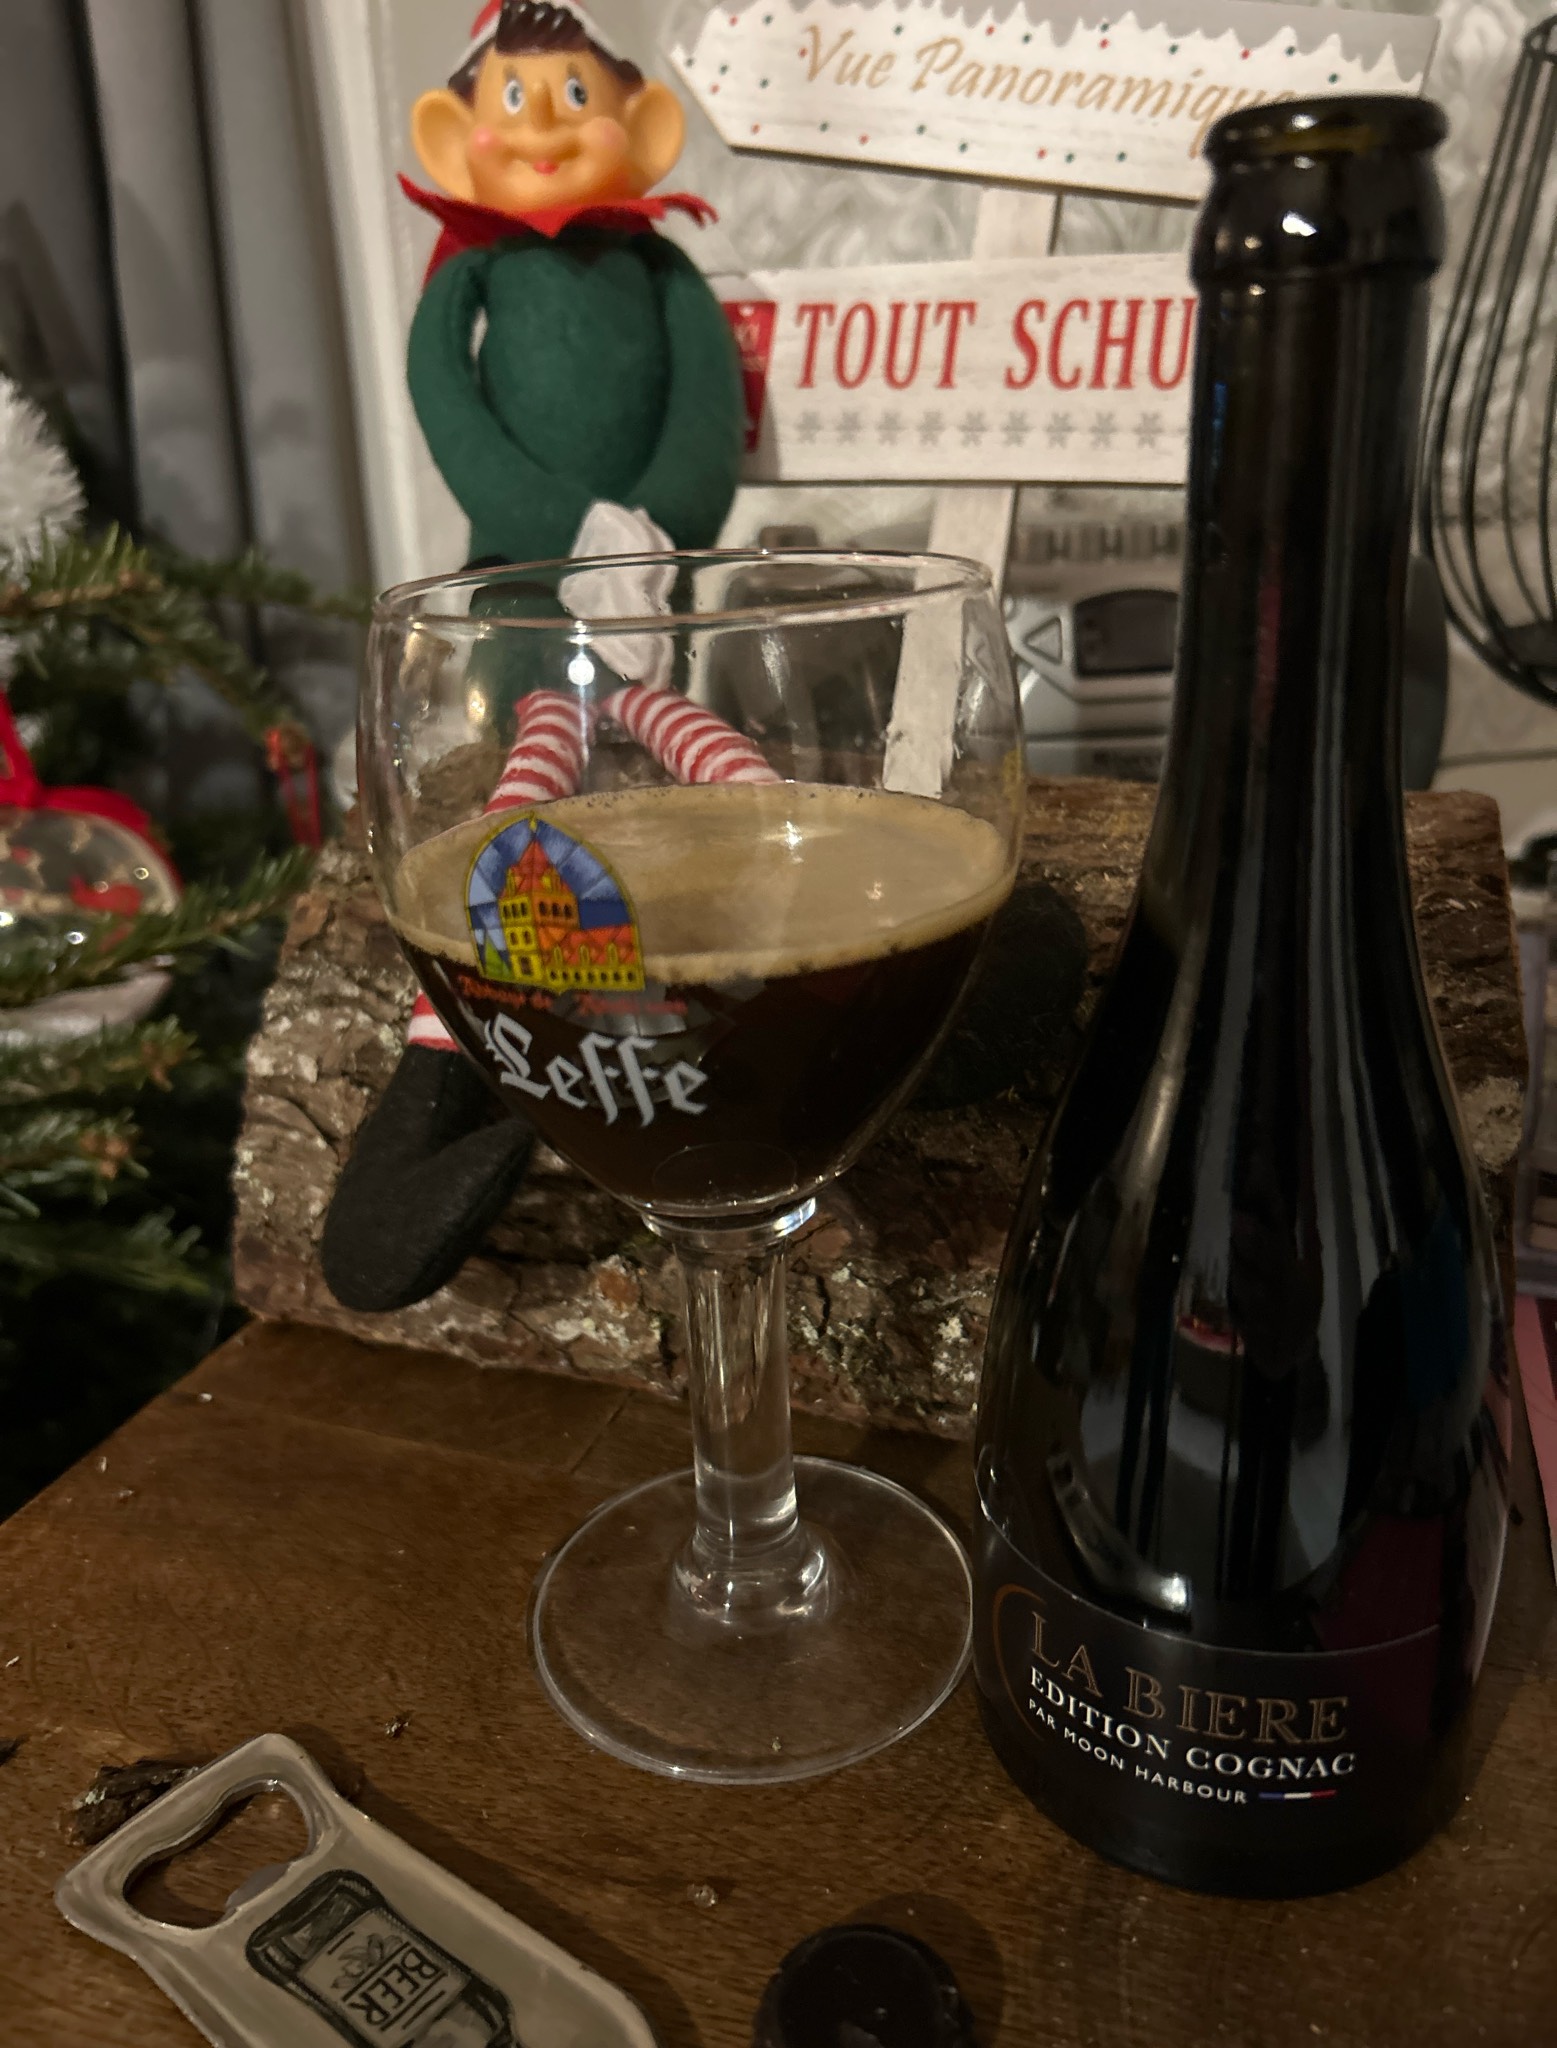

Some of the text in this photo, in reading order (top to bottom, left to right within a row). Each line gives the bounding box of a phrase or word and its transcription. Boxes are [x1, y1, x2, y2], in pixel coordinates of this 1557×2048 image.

[803, 25, 1296, 159] Vue Panoramiqu
[795, 301, 976, 390] TOUT
[1005, 297, 1198, 391] SCHU
[485, 1011, 708, 1126] Leffe
[1029, 1666, 1356, 1781] EDITION COGNAC
[1031, 1611, 1350, 1745] LA BIERE
[1028, 1698, 1248, 1805] PAR MOON HARBOUR
[349, 1947, 444, 2026] BEER
